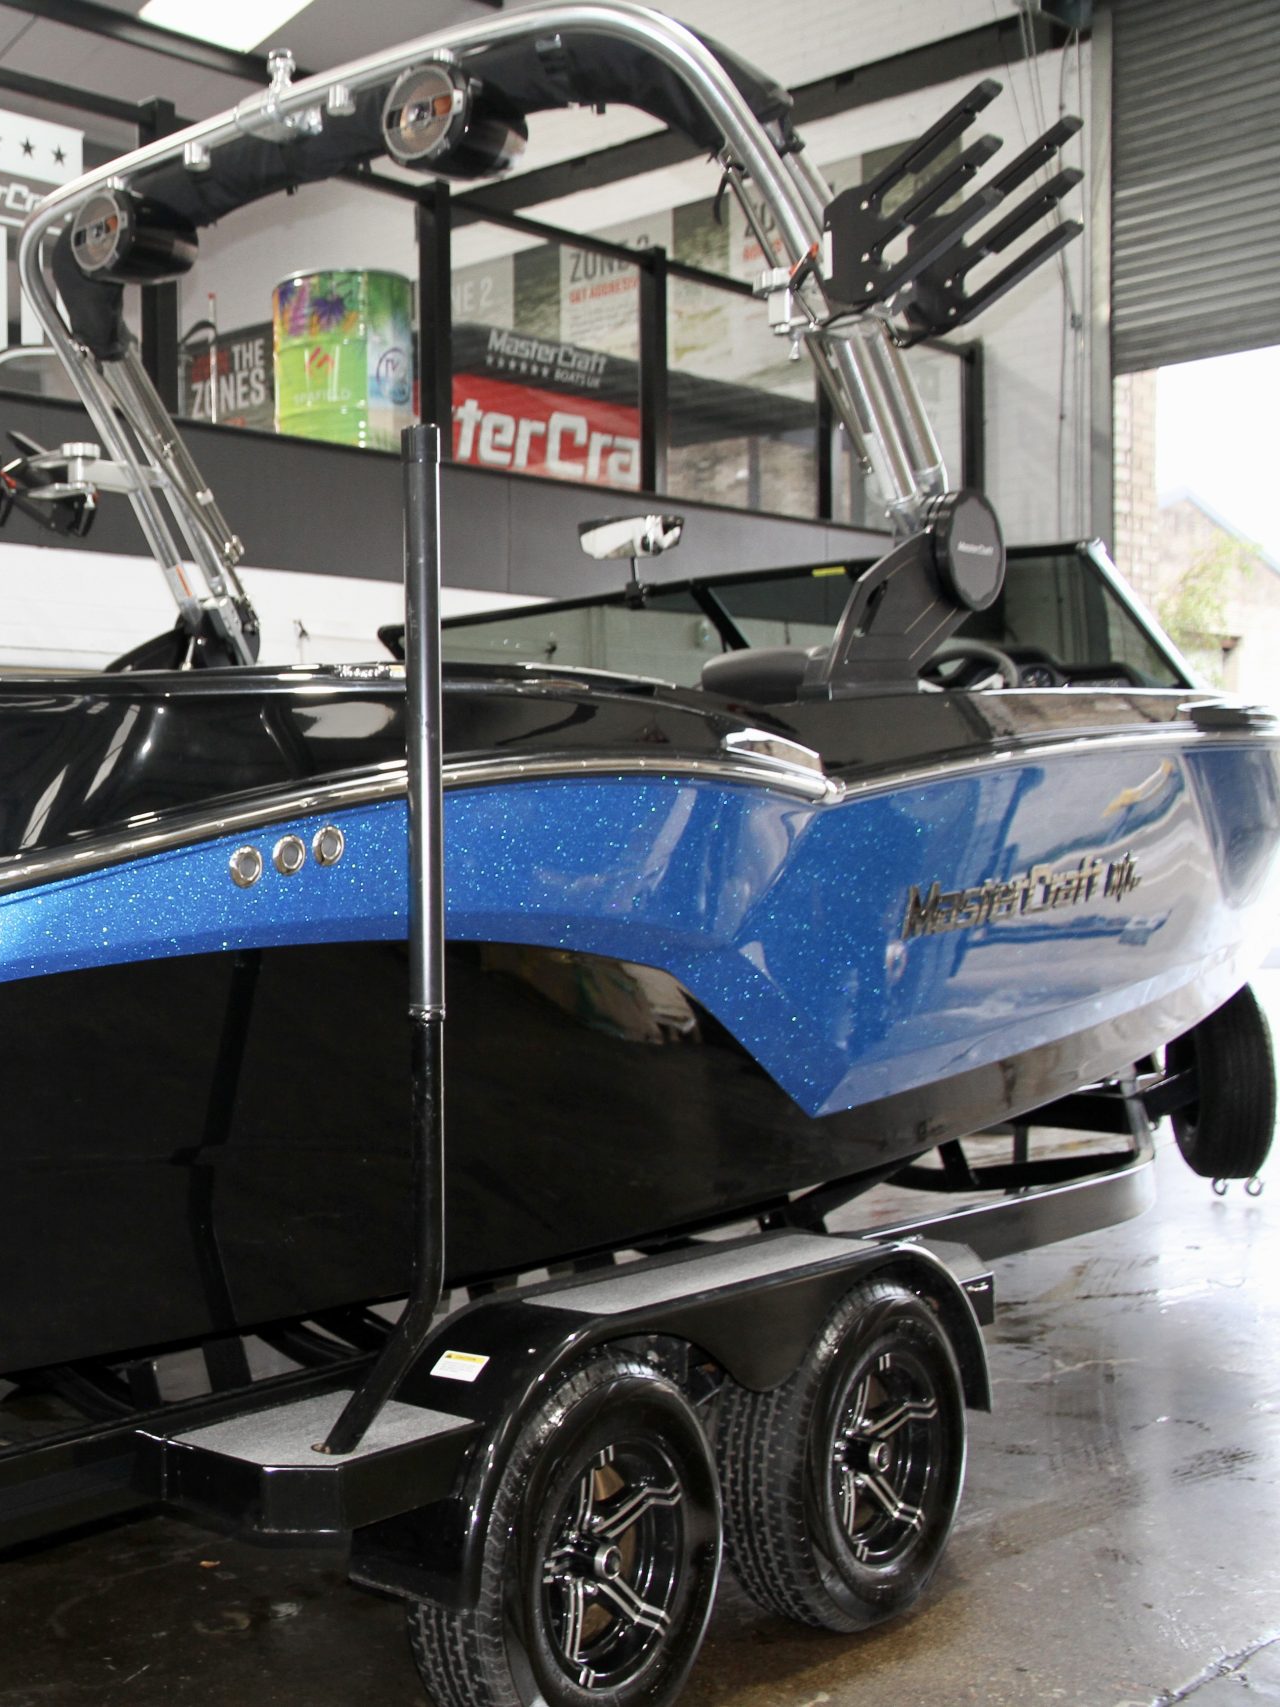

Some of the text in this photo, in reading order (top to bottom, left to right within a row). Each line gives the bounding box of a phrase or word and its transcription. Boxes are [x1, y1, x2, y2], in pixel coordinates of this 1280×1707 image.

[231, 338, 265, 373] THE
[487, 328, 607, 374] MasterCraft
[451, 398, 641, 485] terCra
[901, 855, 1104, 941] MasterCraft
